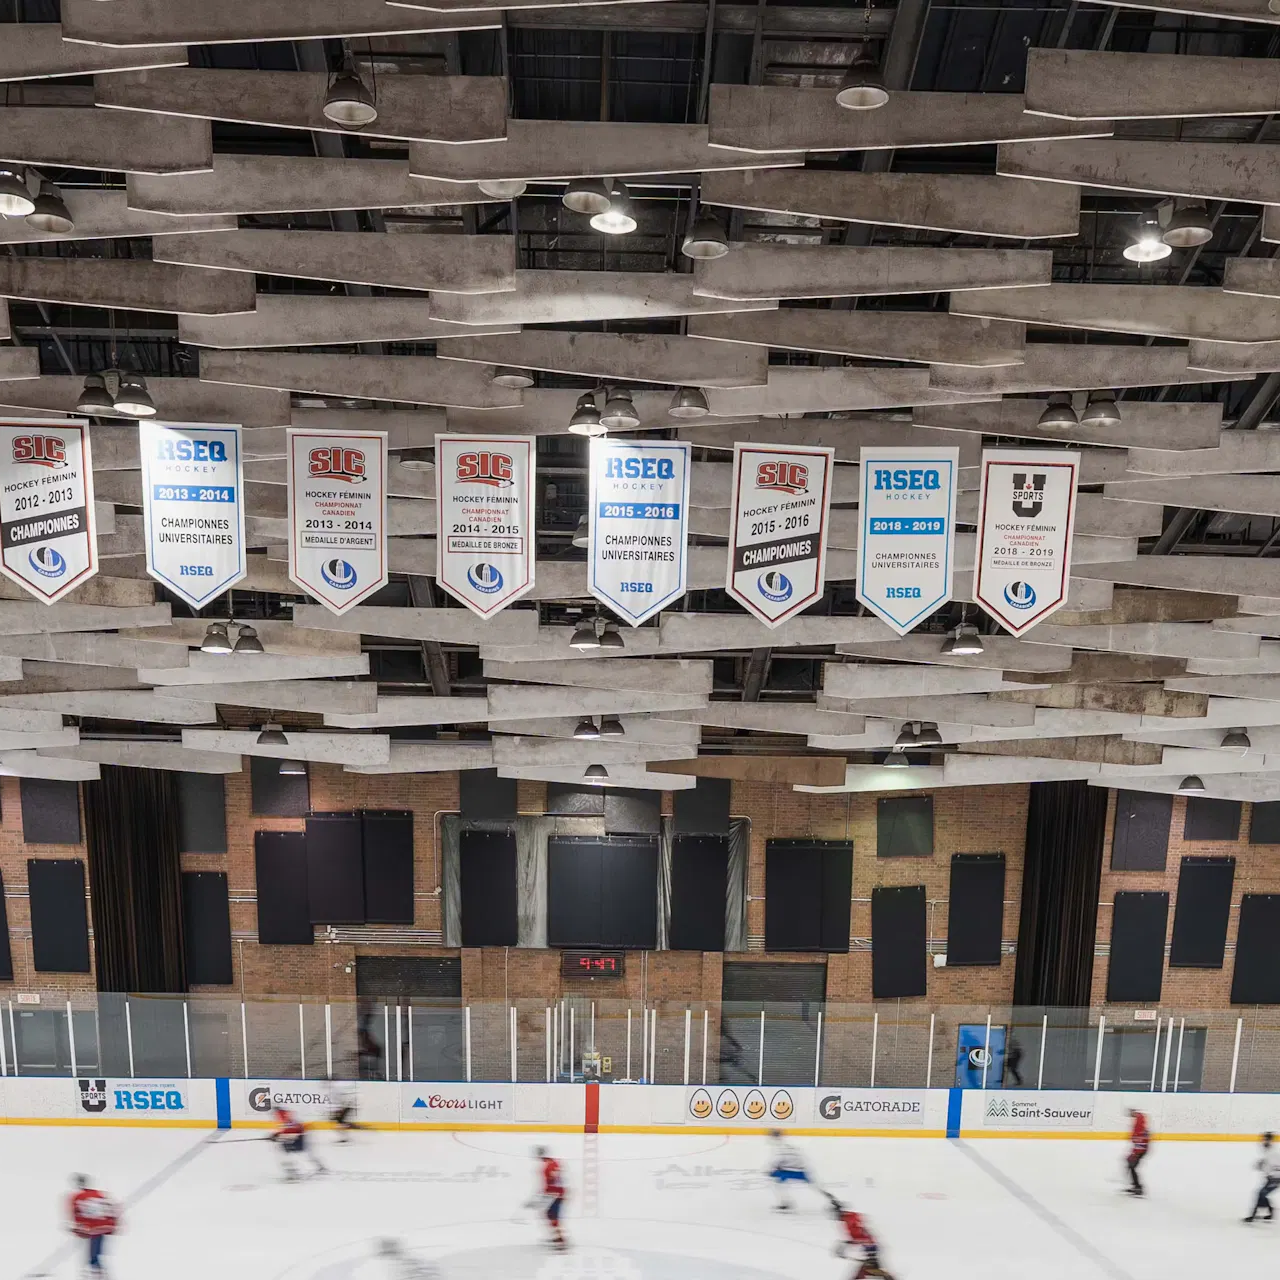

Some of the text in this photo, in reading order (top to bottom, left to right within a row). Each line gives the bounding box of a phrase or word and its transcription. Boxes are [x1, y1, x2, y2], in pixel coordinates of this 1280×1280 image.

[12, 435, 66, 461] SIC
[157, 440, 227, 462] RSEQ
[309, 447, 365, 475] SIC
[457, 452, 513, 480] SIC
[605, 458, 675, 479] RSEQ
[756, 462, 808, 489] SIC
[874, 470, 941, 490] RSEQ
[5, 472, 77, 492] HOCKEY FÉMININ
[15, 495, 39, 511] 2012
[49, 487, 73, 505] 2013
[159, 488, 188, 499] 2013
[200, 489, 229, 500] 2014
[339, 491, 371, 499] FÉMININ
[487, 495, 518, 504] FÉMININ
[1013, 491, 1043, 500] SPORTS
[605, 506, 633, 517] 2015
[645, 507, 674, 518] 2016
[744, 498, 815, 517] HOCKEY FÉMININ
[10, 514, 79, 541] CHAMPIONNES
[162, 518, 229, 529] CHAMPIONNES
[306, 520, 333, 529] 2013
[345, 521, 372, 530] 2014
[453, 524, 480, 533] 2014
[492, 525, 519, 534] 2015
[752, 520, 775, 536] 2015
[785, 514, 809, 530] 2016
[874, 522, 902, 531] 2018
[912, 522, 940, 531] 2019
[995, 523, 1056, 532] HOCKEY FÉMININ
[159, 533, 232, 544] UNIVERSITAIRES
[340, 537, 373, 545] D'ARGENT
[605, 535, 672, 546] CHAMPIONNES
[452, 540, 481, 548] MÉDAILLE
[484, 541, 492, 549] DE
[602, 550, 674, 561] UNIVERSITAIRES
[743, 540, 811, 565] CHAMPIONNES
[994, 547, 1018, 555] 2018
[1030, 548, 1053, 556] 2019
[180, 565, 214, 576] RSEQ
[620, 582, 653, 592] RSEQ
[886, 588, 921, 598] RSEQ
[114, 1091, 184, 1109] RSEQ
[429, 1095, 503, 1110] Coors LIGHT
[843, 1101, 920, 1112] GATORADE
[1011, 1108, 1091, 1119] Saint-Sauveur
